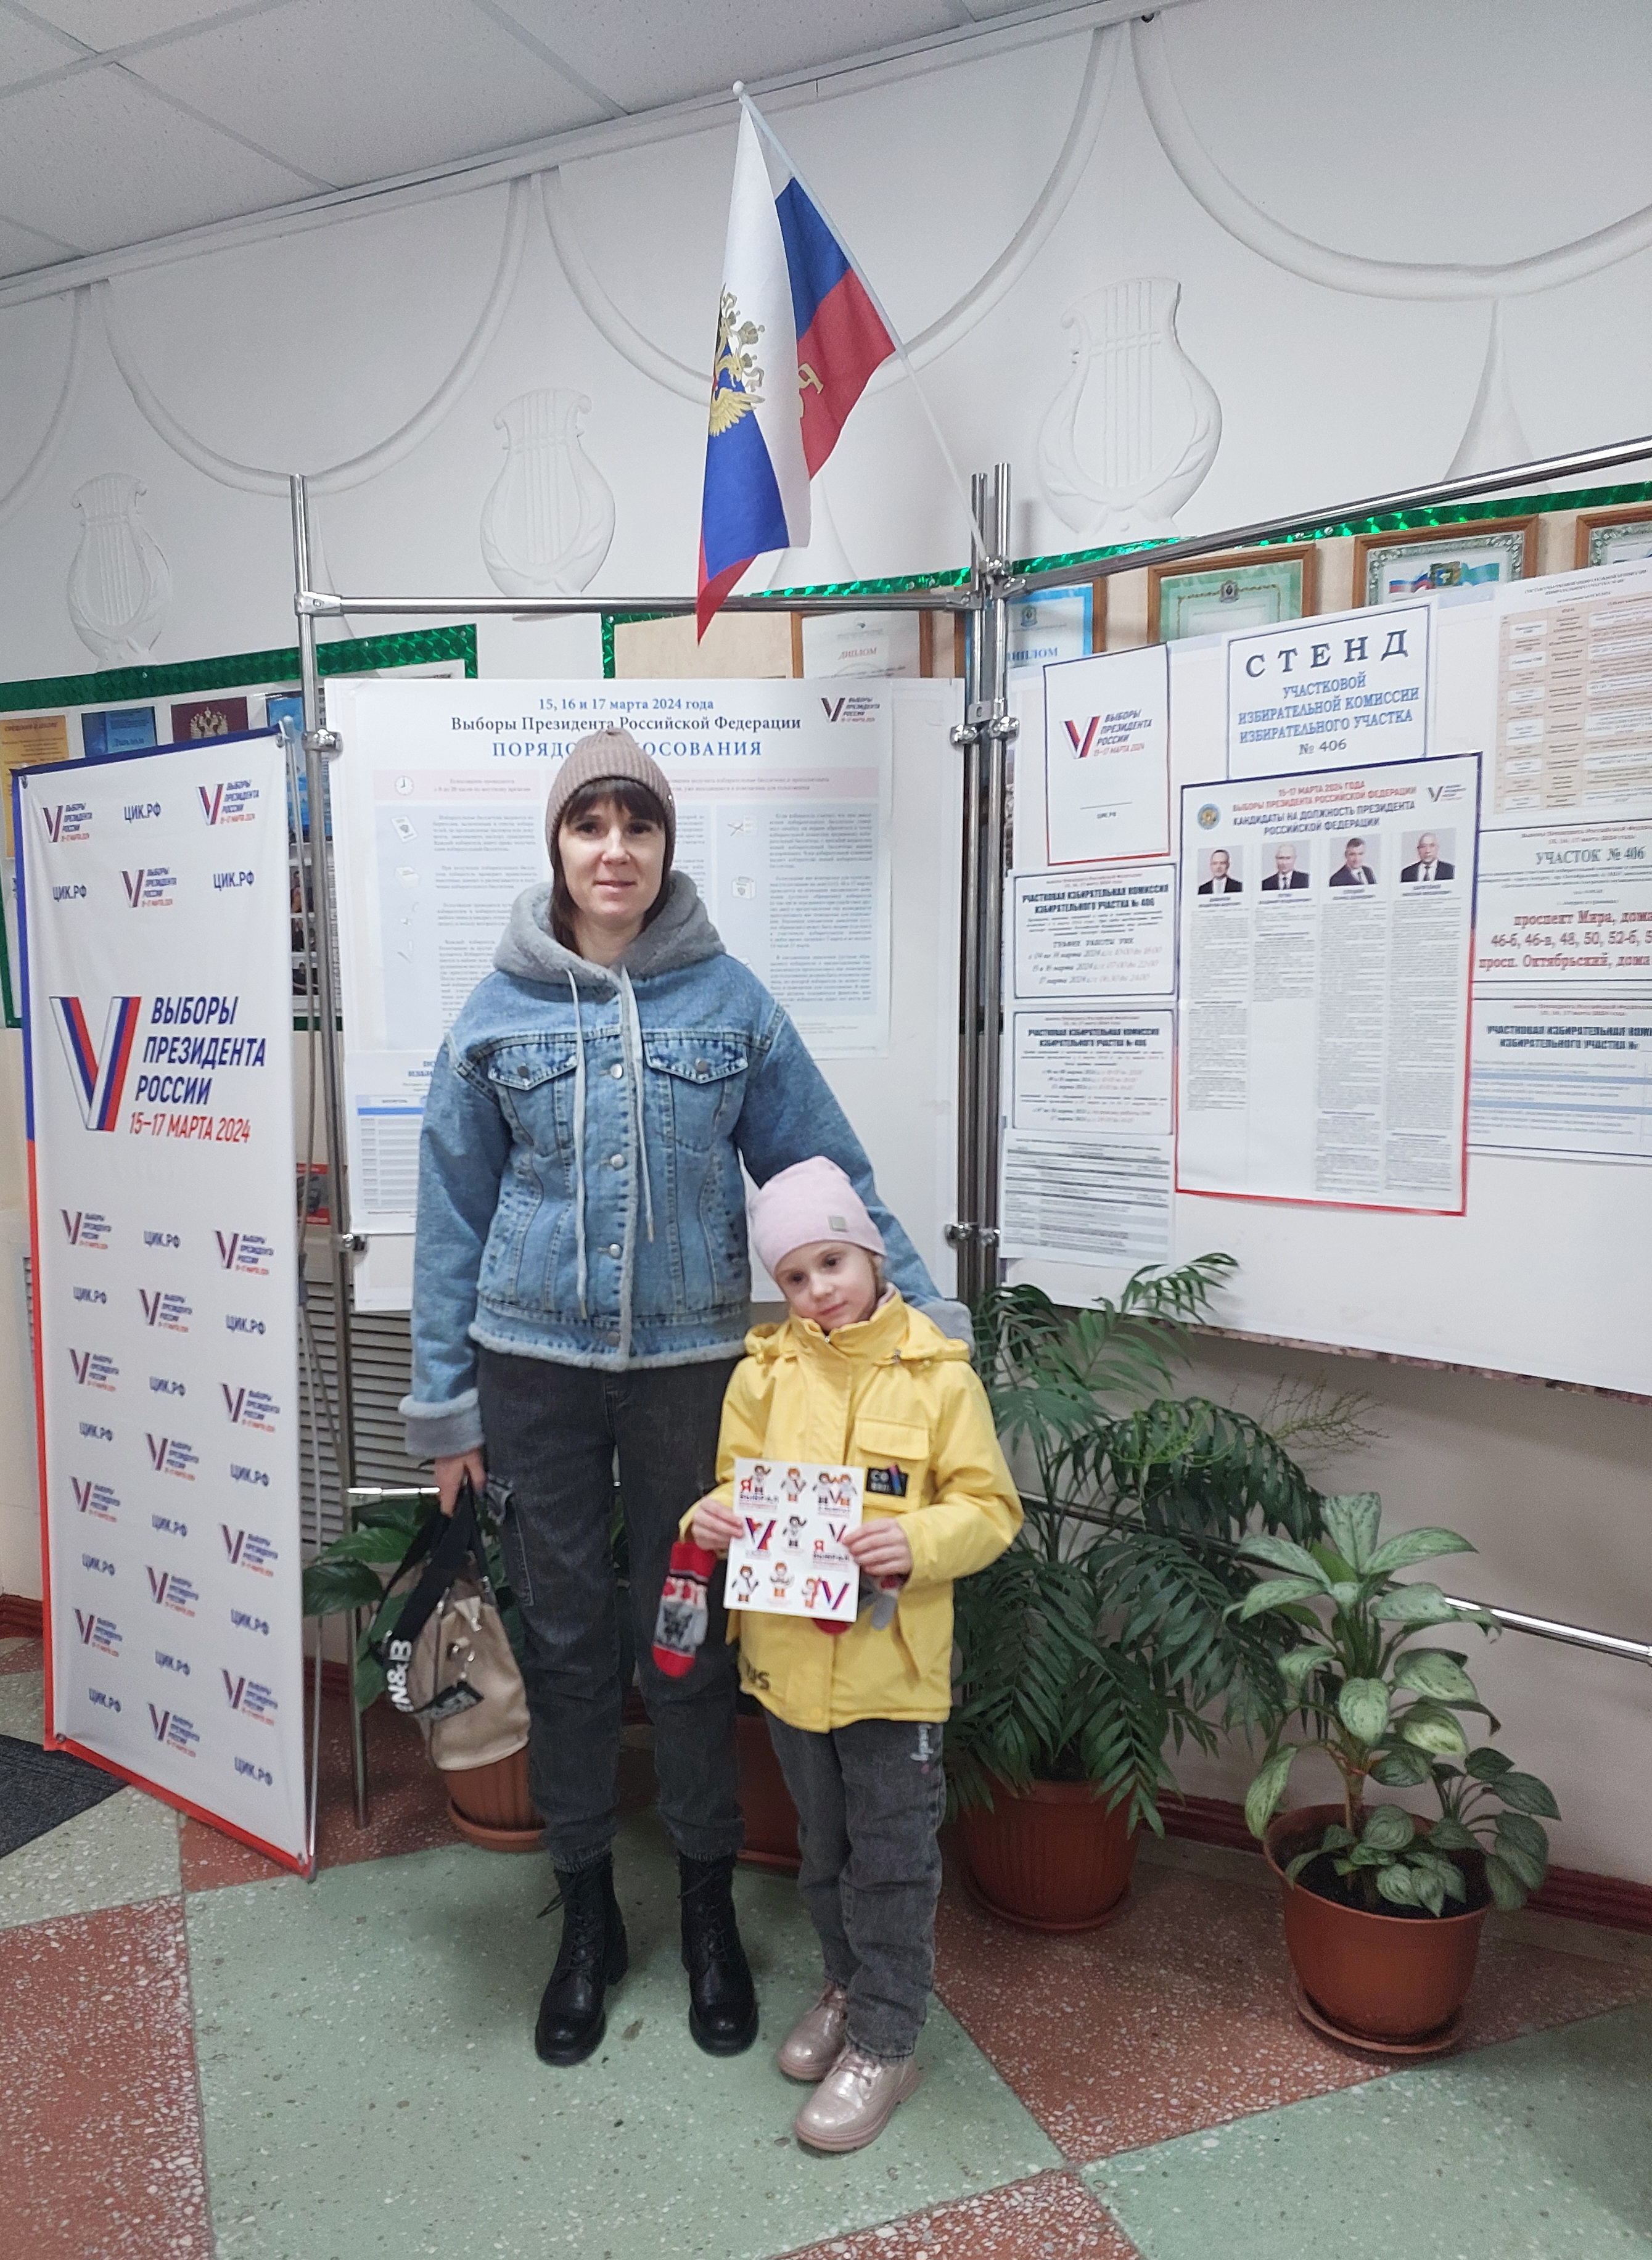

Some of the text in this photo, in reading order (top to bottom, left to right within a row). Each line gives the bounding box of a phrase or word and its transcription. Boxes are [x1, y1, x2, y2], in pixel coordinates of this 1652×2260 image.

[1246, 629, 1409, 678] СТЕНД
[1283, 671, 1366, 699] УЧАСТКОВОЙ
[539, 699, 714, 713] 15, 16 и 17 марта 2024 года
[1104, 709, 1142, 723] ВЫБОРЫ
[1238, 687, 1421, 725] ИЗБИРАТЕЛЬНОЙ КОМИССИИ
[451, 715, 801, 733] Выборы Президента Российской Федерации
[1101, 718, 1153, 734] ПРЕЗИДЕНТА
[1239, 709, 1413, 744] ИЗБИРАТЕЛЬНОГО УЧАСТКА
[1097, 733, 1130, 746] РОССИИ
[1320, 739, 1347, 752] 406
[493, 742, 577, 758] ПОРЯДО
[124, 801, 162, 823] ЦИК.РФ
[1535, 849, 1601, 865] УЧАСТОК
[1624, 845, 1646, 860] 406
[213, 870, 255, 891] ЦИК.РФ
[53, 884, 87, 902] ЦИК.РФ
[1514, 914, 1574, 929] проспект
[151, 996, 239, 1025] ВЫБОРЫ
[143, 1036, 266, 1070] ПРЕЗИДЕНТА
[135, 1075, 213, 1106] РОССИИ
[166, 1114, 213, 1140] МАРТА
[216, 1117, 251, 1144] 2024
